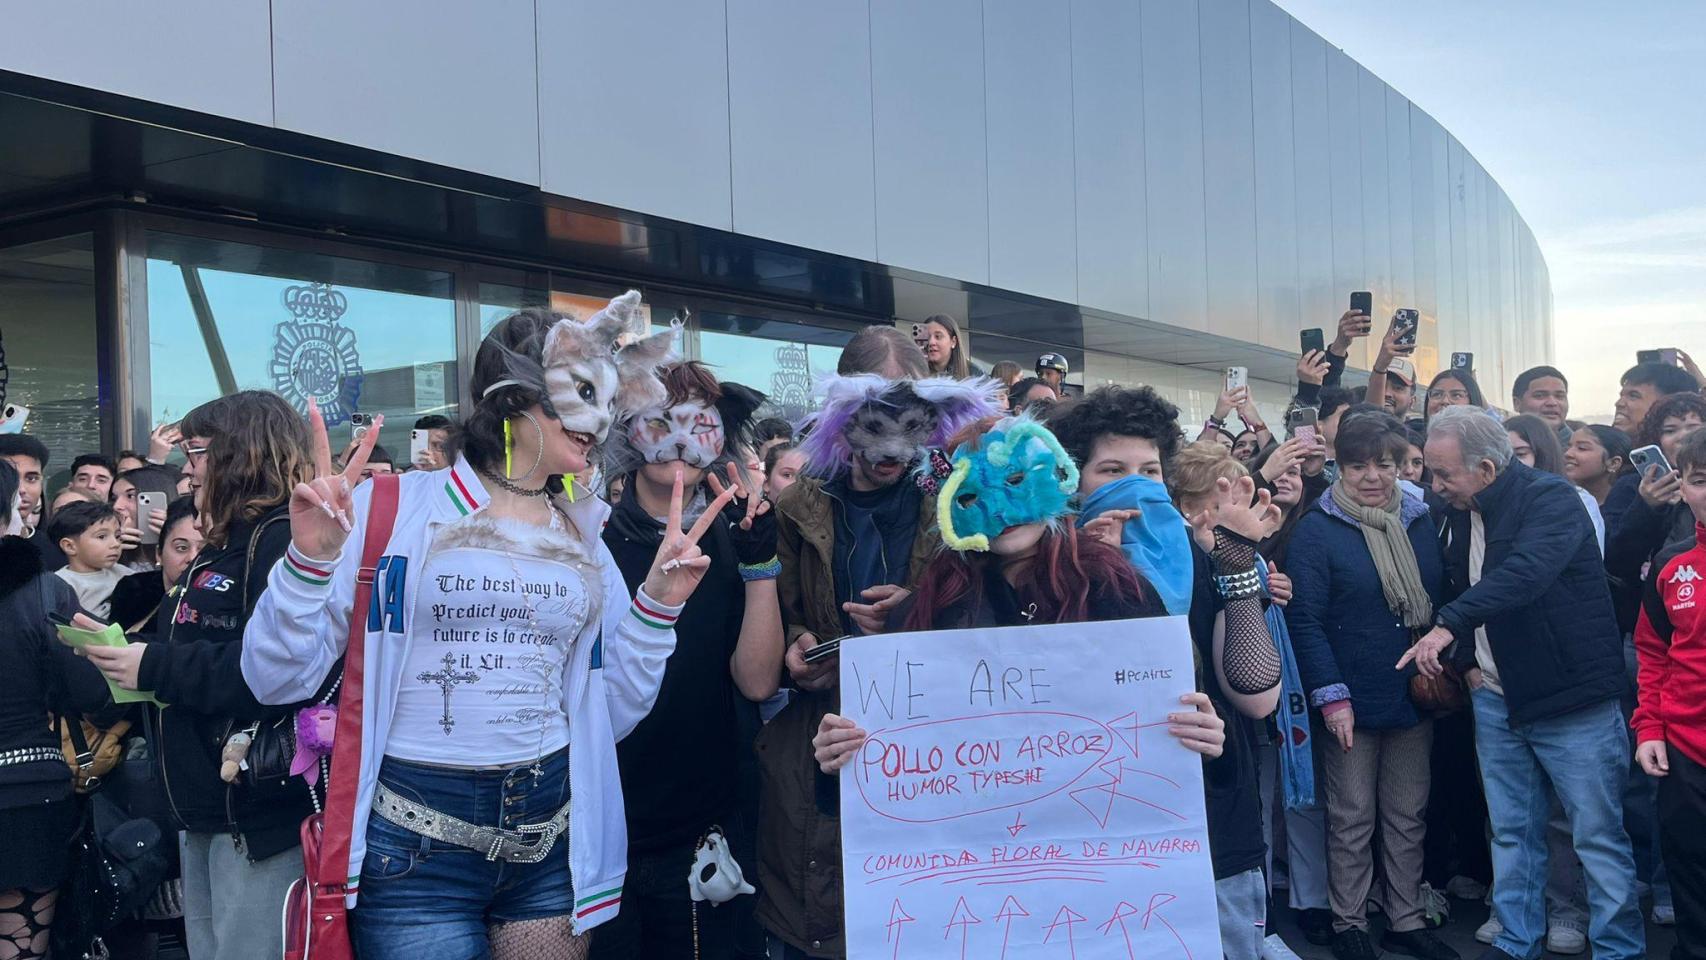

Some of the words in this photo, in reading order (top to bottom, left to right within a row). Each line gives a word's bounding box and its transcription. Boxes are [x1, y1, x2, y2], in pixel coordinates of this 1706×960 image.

[299, 387, 339, 402] NAIONAL
[435, 574, 475, 593] The
[483, 575, 515, 593] best
[521, 583, 551, 599] way
[555, 581, 567, 597] to
[432, 603, 496, 622] Predict
[500, 608, 535, 622] your
[433, 627, 480, 643] future
[485, 628, 498, 643] is
[503, 629, 515, 644] to
[519, 632, 557, 646] create
[852, 650, 929, 720] WE
[969, 658, 1051, 706] ARE
[862, 738, 943, 783] POLLO
[955, 741, 1001, 768] CON
[1016, 731, 1108, 760] ARROZ
[888, 774, 961, 801] HUMOR
[863, 850, 979, 874] COMUNIDAD
[991, 844, 1071, 864] FLORAL
[1082, 840, 1108, 858] DE
[1121, 838, 1201, 855] NAVARRA
